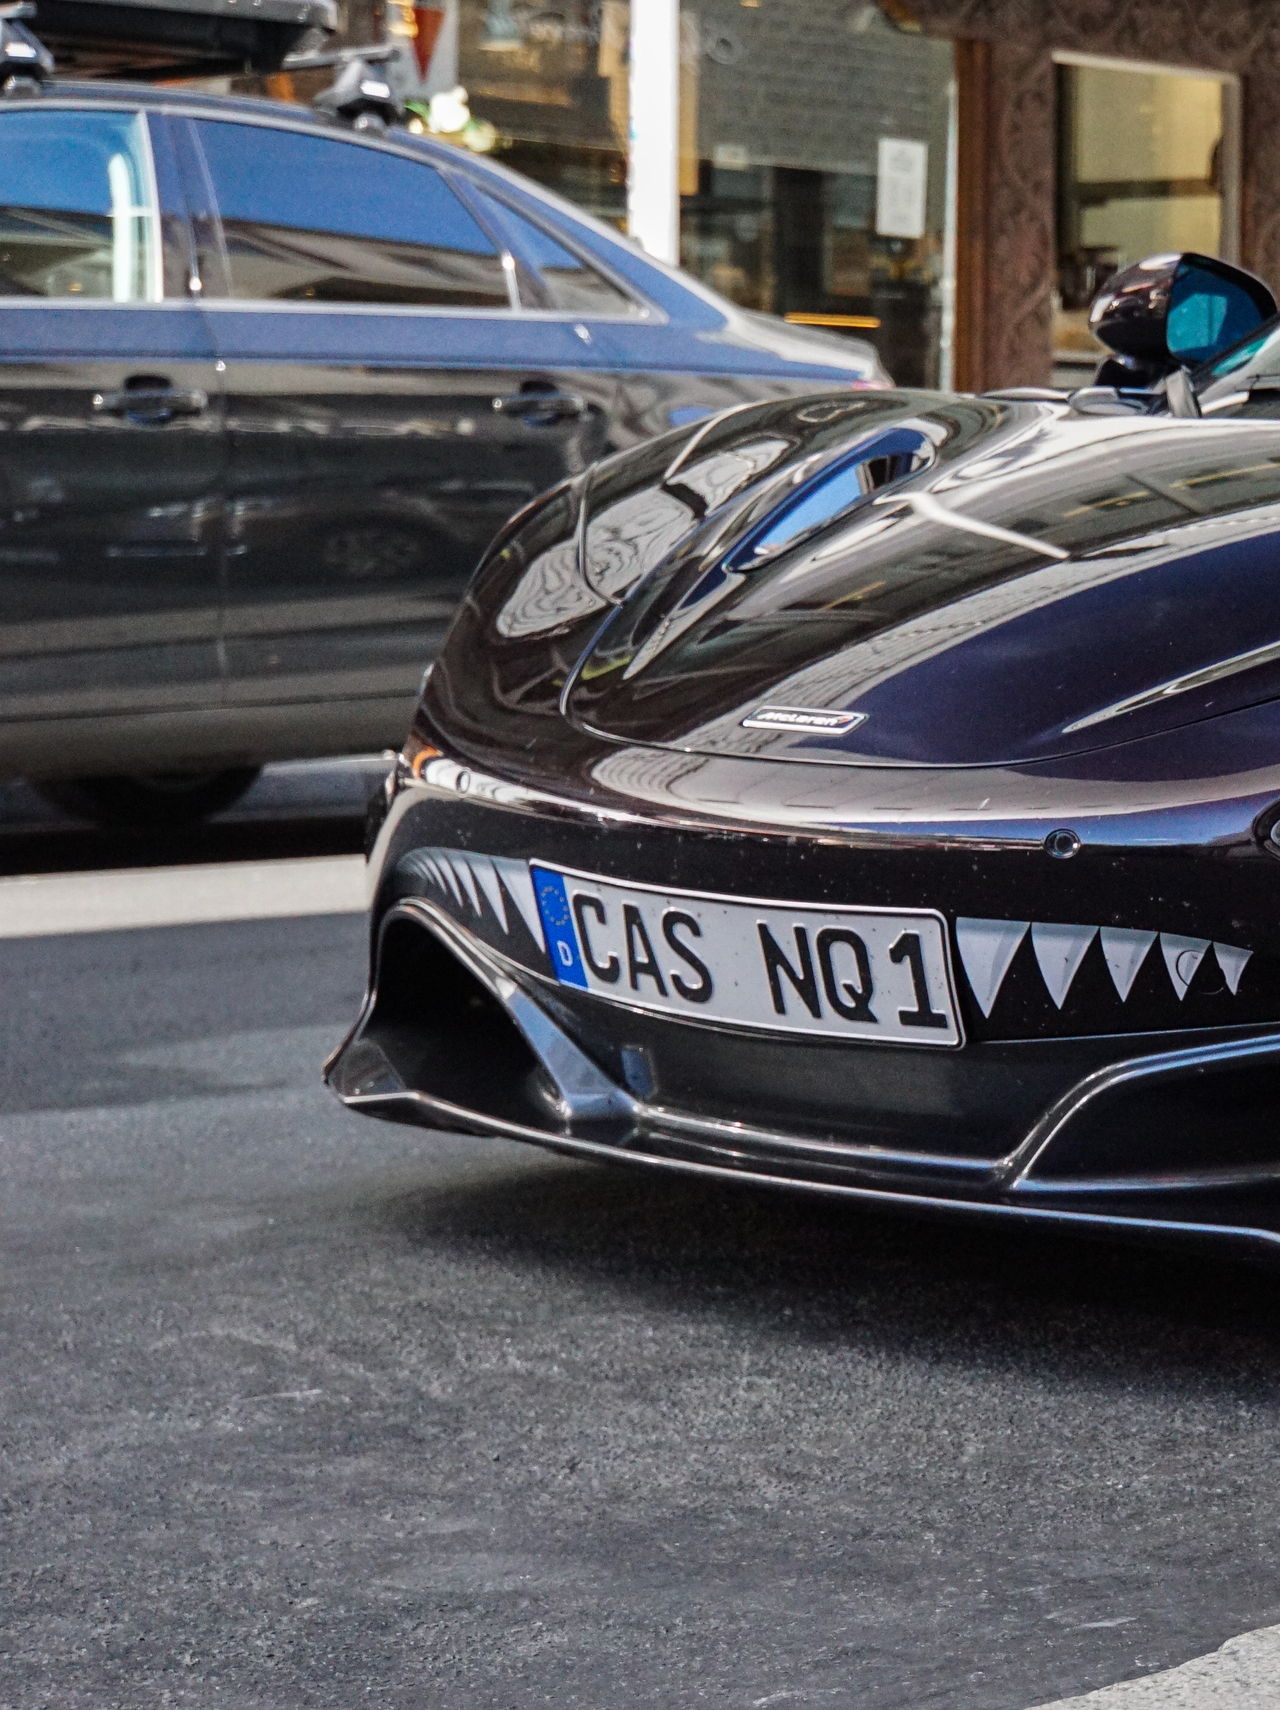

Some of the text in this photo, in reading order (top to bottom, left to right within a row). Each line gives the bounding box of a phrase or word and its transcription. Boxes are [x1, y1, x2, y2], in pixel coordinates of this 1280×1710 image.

[757, 711, 838, 726] McLaren
[557, 941, 573, 966] D
[573, 889, 713, 1003] CAS
